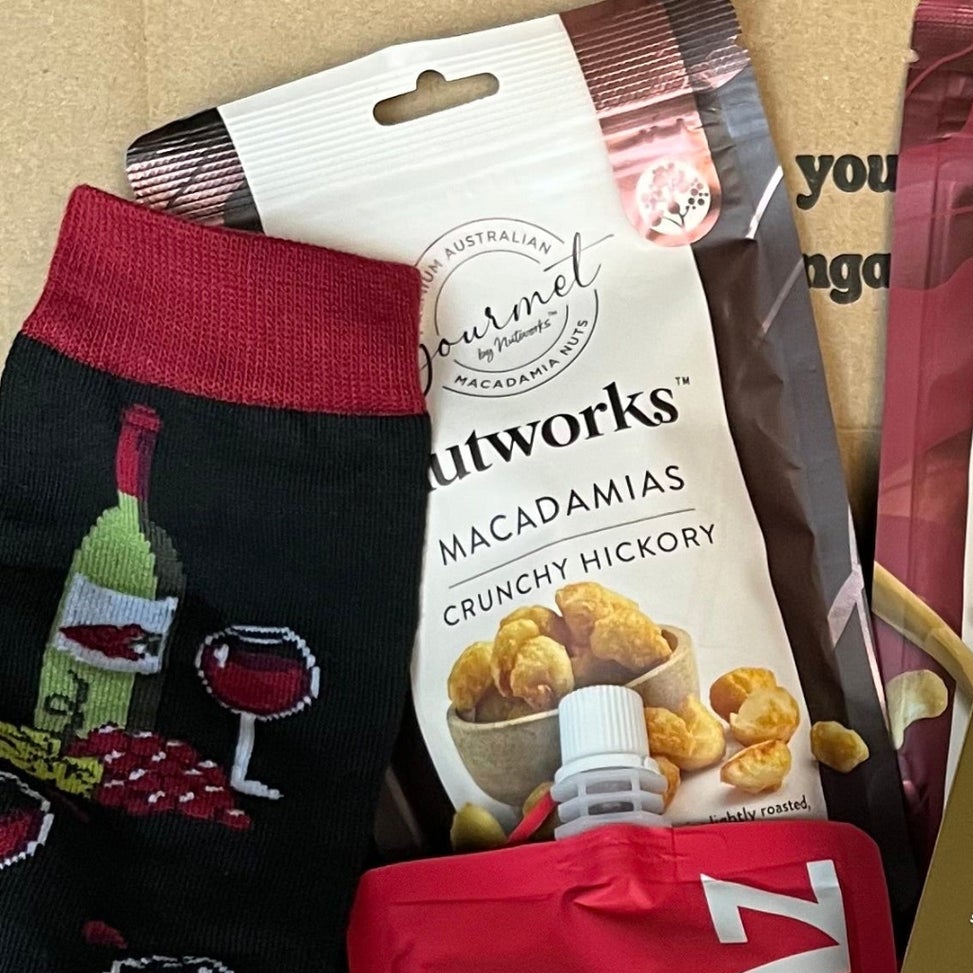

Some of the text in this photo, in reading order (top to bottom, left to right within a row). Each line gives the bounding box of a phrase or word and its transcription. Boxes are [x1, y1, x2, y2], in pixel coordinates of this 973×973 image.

[444, 230, 552, 260] AUSTRALIAN
[453, 319, 588, 389] MACADAMIA NUTS
[428, 381, 679, 493] utworks
[438, 465, 685, 566] MACADAMIAS
[442, 524, 715, 626] CRUNCHY HICKORY
[760, 795, 811, 817] roasted,
